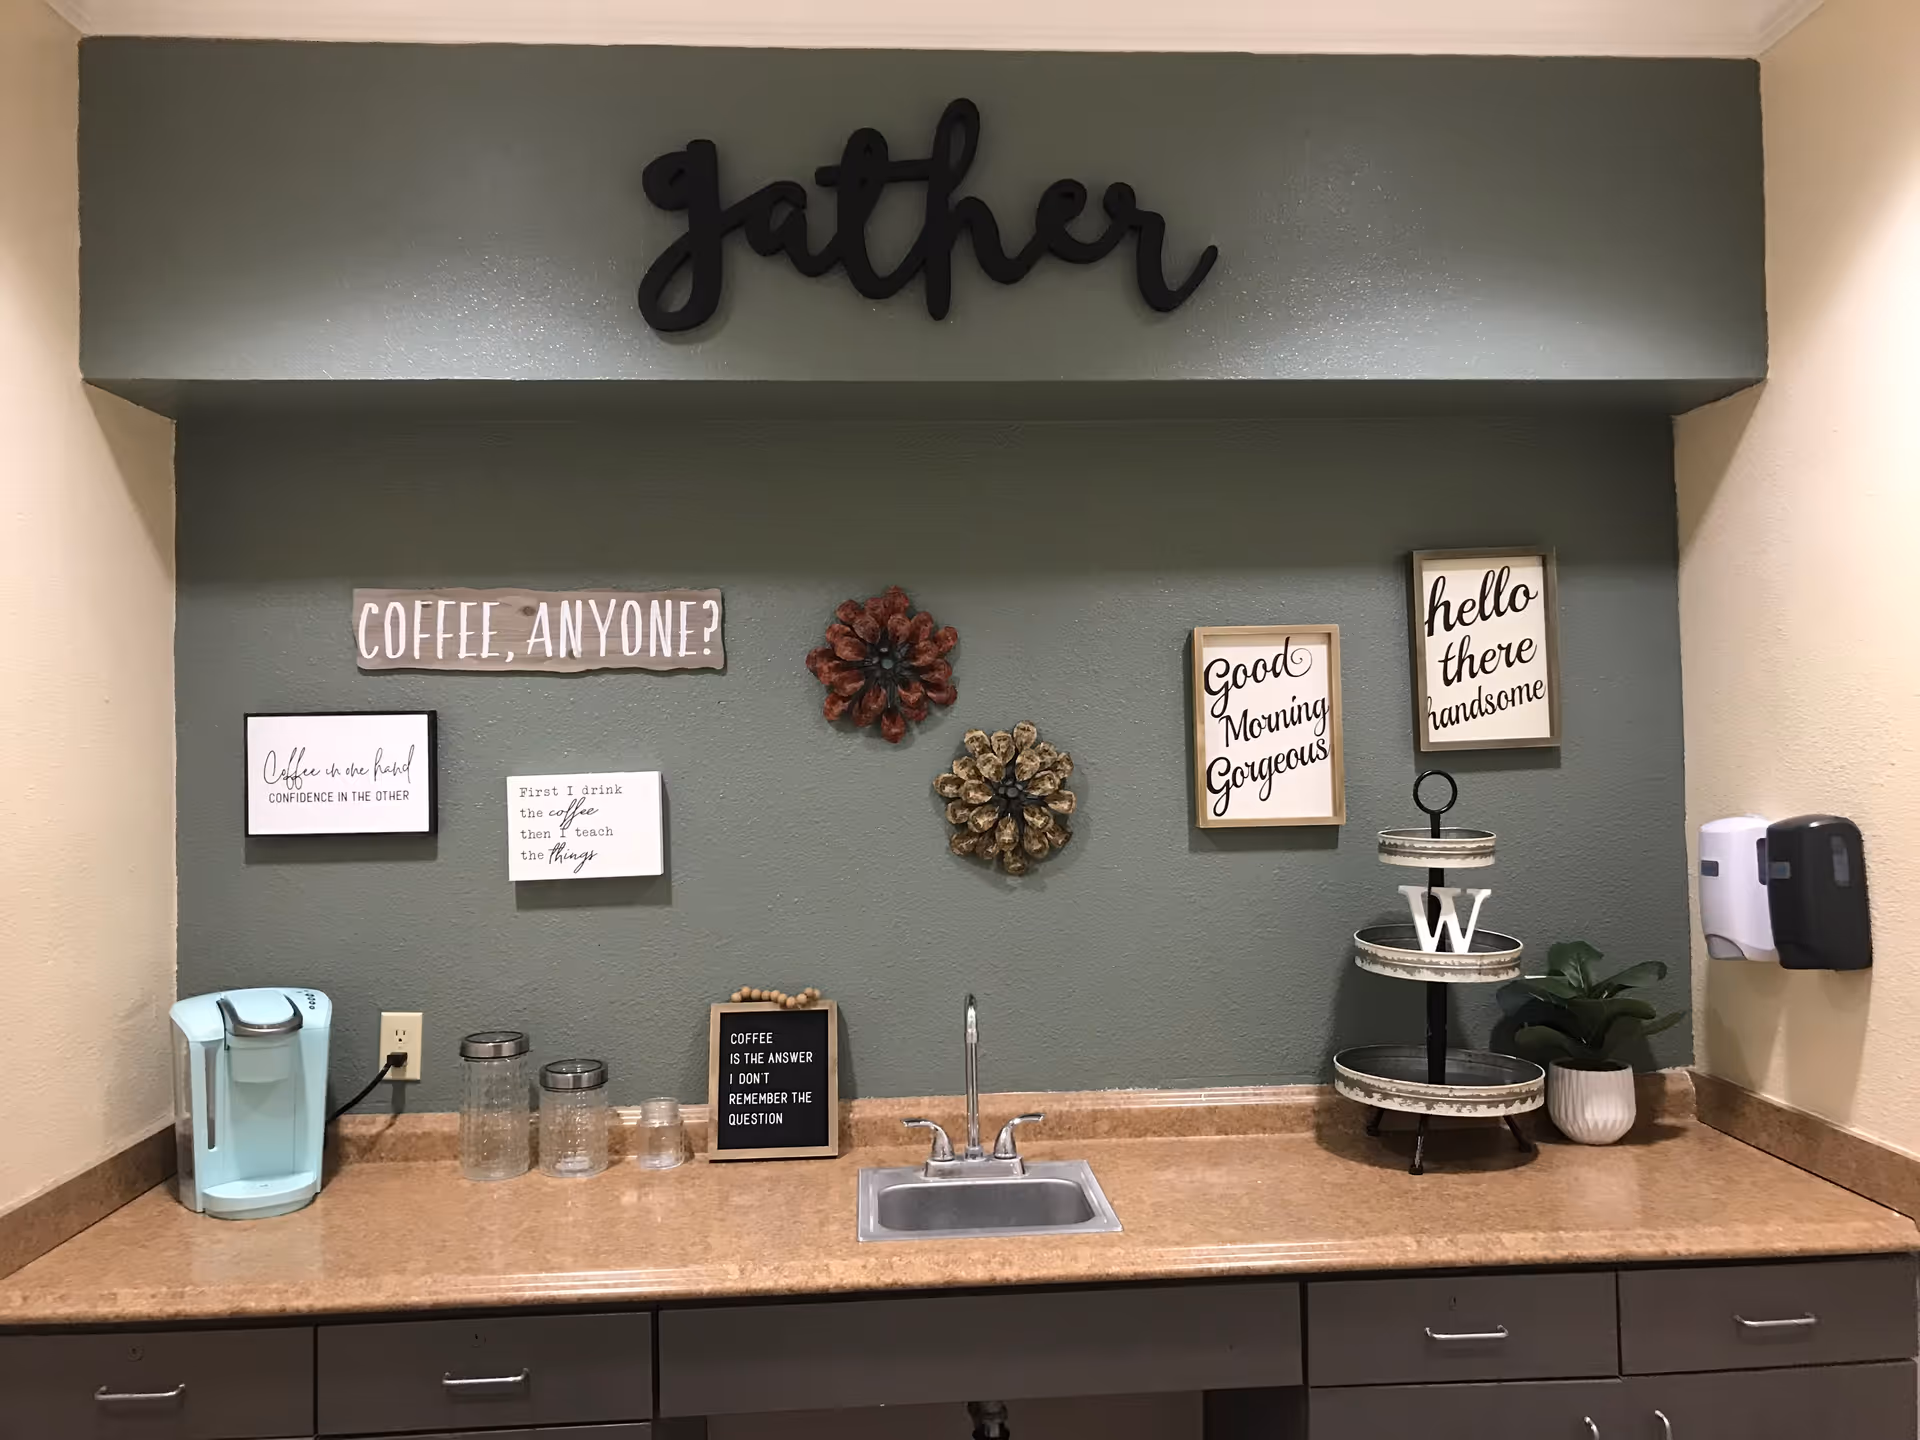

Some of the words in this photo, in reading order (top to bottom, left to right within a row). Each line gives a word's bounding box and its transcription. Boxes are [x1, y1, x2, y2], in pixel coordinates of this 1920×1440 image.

[638, 97, 1218, 332] gather
[1425, 566, 1538, 637] hello
[358, 600, 514, 662] COFFEE,
[526, 599, 719, 658] ANYONE?
[1204, 636, 1312, 718] Good
[1438, 634, 1537, 687] there
[1218, 695, 1330, 747] Morning
[264, 747, 320, 790] Coffee
[326, 763, 341, 777] in
[345, 762, 369, 777] one
[374, 744, 415, 784] hand
[1206, 738, 1330, 817] Gorgeous
[269, 791, 334, 803] CONFIDENCE
[338, 792, 348, 801] IN
[352, 791, 371, 801] THE
[376, 790, 410, 801] OTHER
[519, 786, 559, 797] First
[567, 786, 574, 795] I
[581, 784, 623, 795] drink
[520, 808, 543, 818] the
[549, 797, 599, 830] coffee
[520, 829, 551, 839] then
[559, 828, 567, 838] I
[575, 826, 613, 837] teach
[521, 850, 544, 860] the
[548, 842, 598, 873] things
[1398, 885, 1492, 954] W
[730, 1032, 773, 1045] COFFEE
[730, 1053, 740, 1065] IS
[744, 1052, 764, 1064] THE
[768, 1051, 813, 1064] ANSWER
[729, 1073, 733, 1084] I
[739, 1072, 770, 1084] DON'T
[729, 1092, 788, 1105] REMEMBER
[792, 1092, 812, 1103] THE
[729, 1112, 783, 1125] QUESTION
